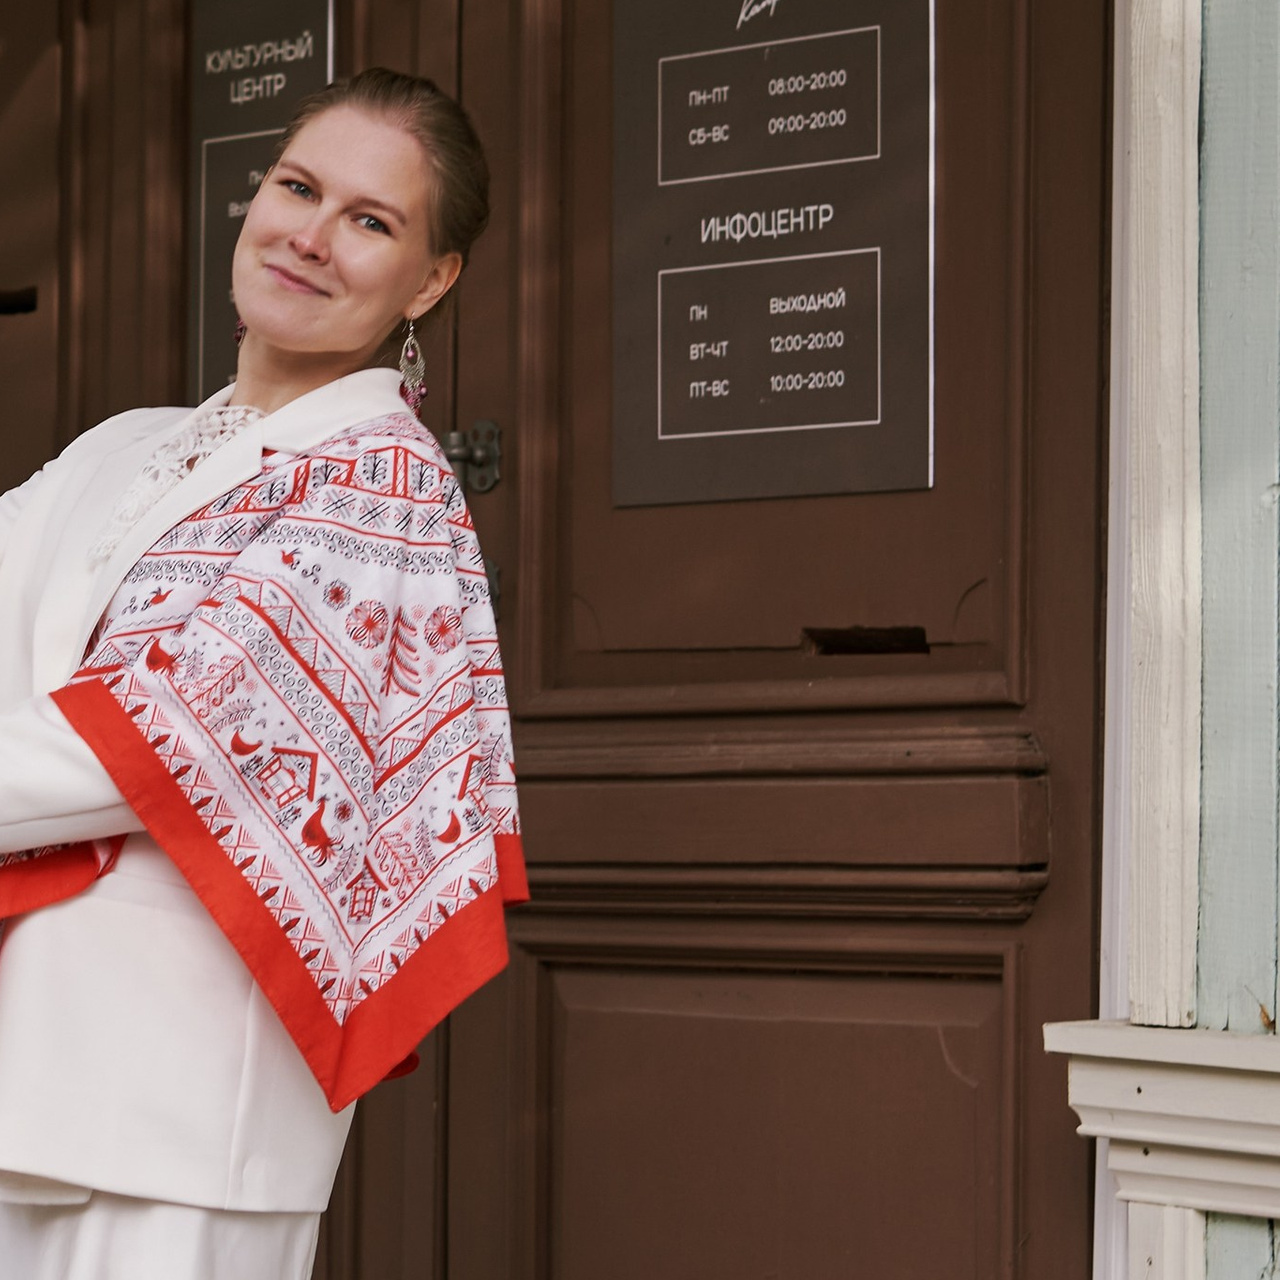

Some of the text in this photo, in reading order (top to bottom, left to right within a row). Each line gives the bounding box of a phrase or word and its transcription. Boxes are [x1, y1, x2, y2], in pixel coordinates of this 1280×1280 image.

[205, 30, 314, 75] КУЛЬТУРНЫЙ
[230, 72, 287, 105] ЦЕНТР
[688, 69, 847, 107] ПН-ПТ 08:00-20:00
[688, 108, 847, 146] СБ-ВС 09:00-20:00
[700, 203, 834, 244] ИНФОЦЕНТР
[689, 287, 846, 321] ПН ВЫХОДНОЙ
[689, 330, 845, 361] ВТ-ЧТ 12:00-20:00
[689, 369, 845, 398] ПТ-ВС 10:00-20:00
